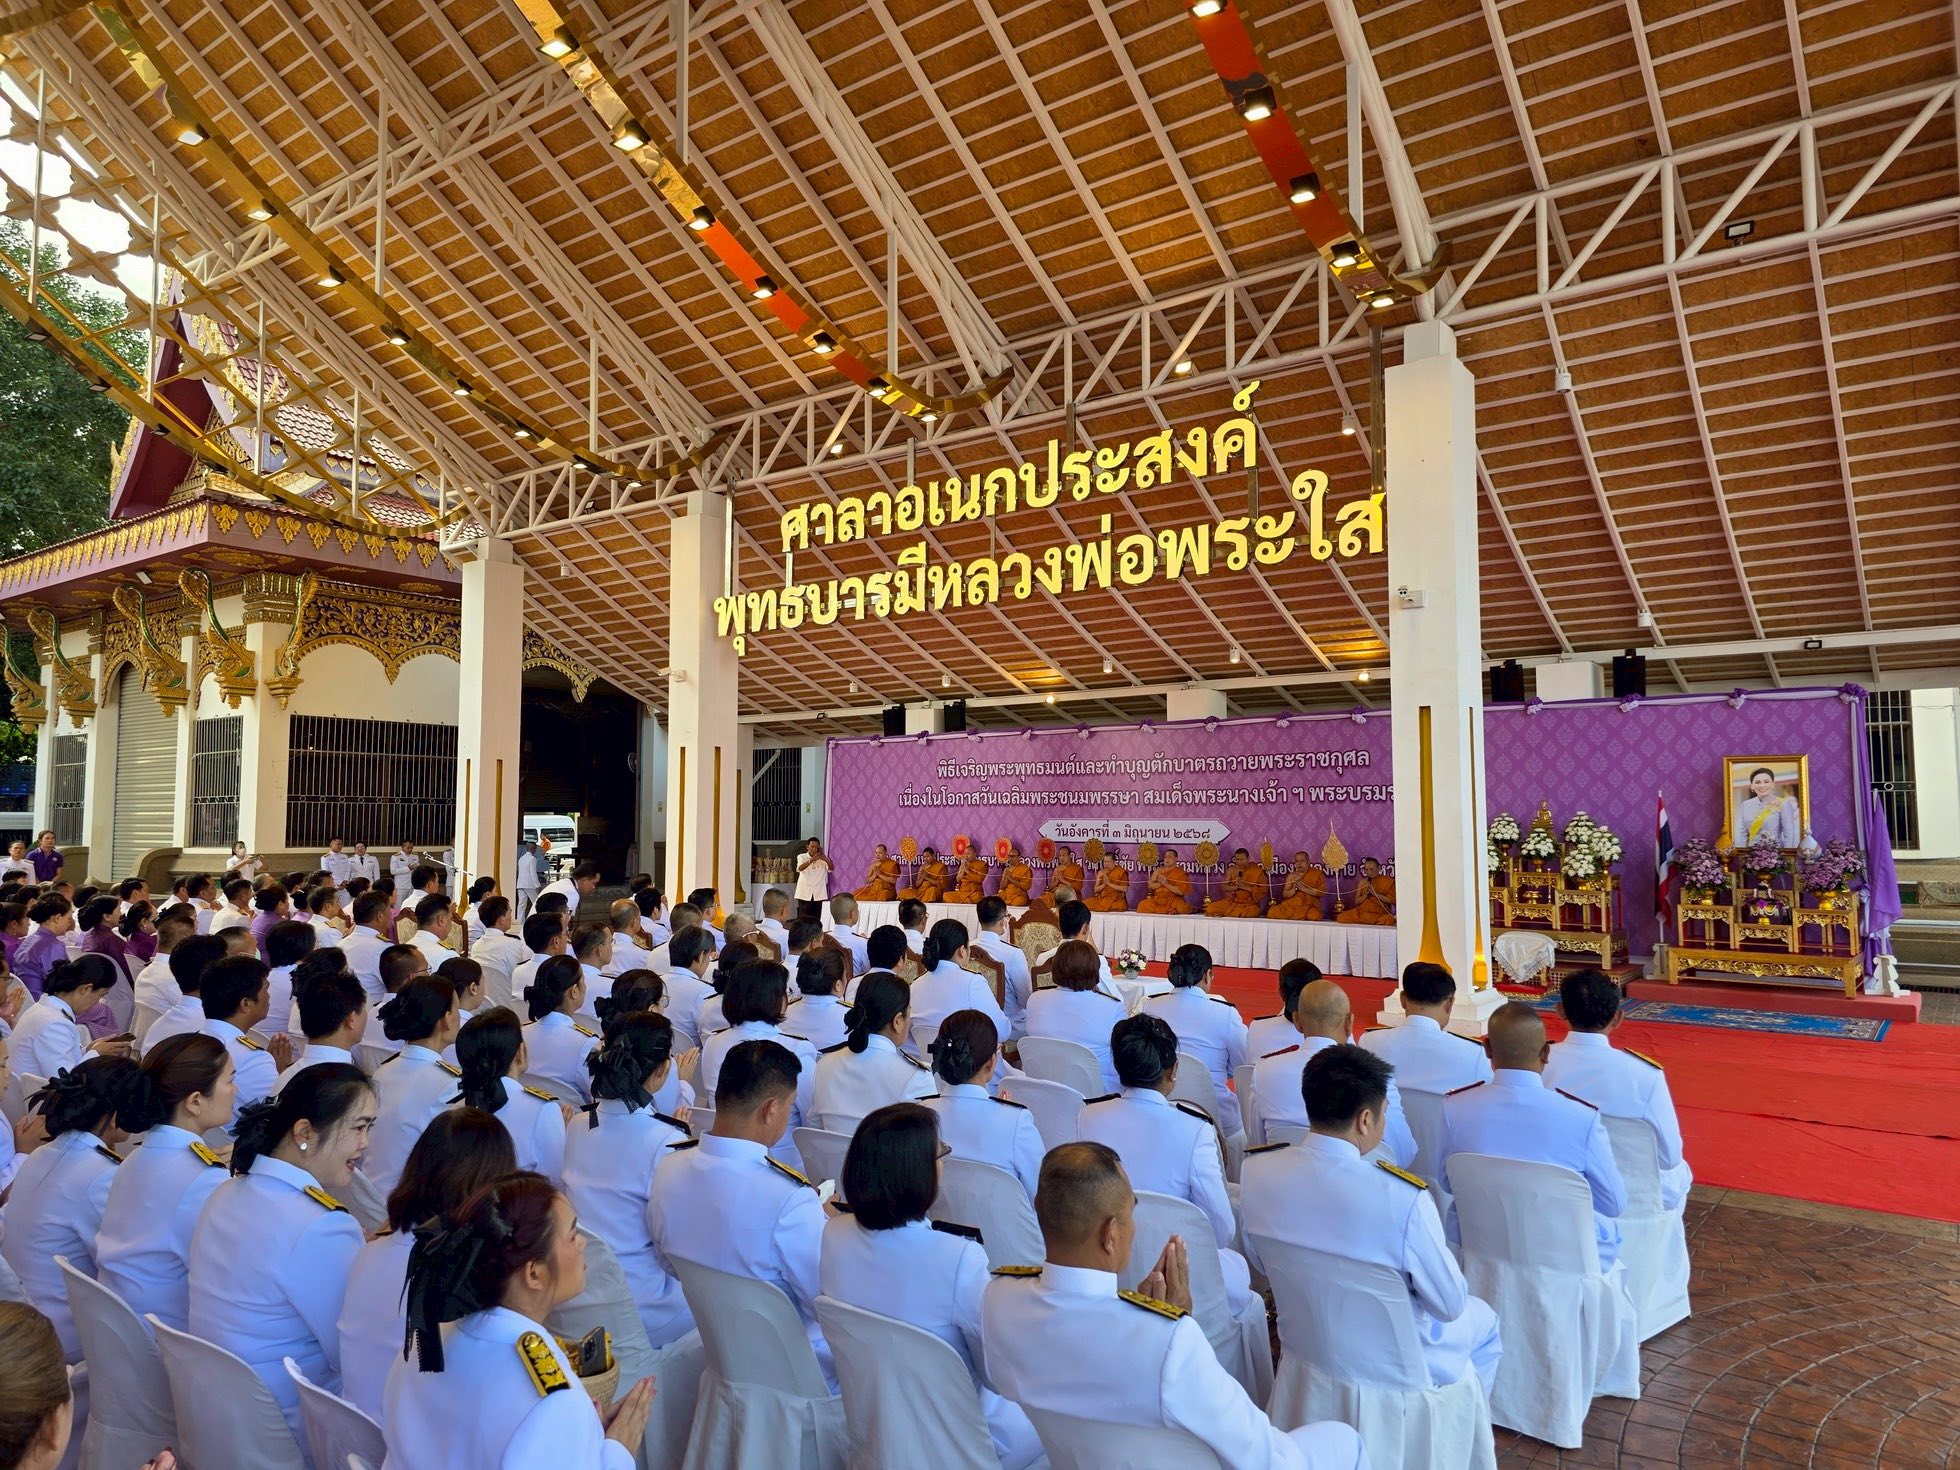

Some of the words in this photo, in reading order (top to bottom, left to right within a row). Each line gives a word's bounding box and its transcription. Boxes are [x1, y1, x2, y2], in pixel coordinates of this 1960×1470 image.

[780, 381, 1260, 553] ศาลาอเนกประสงค์
[713, 469, 1386, 657] พุทธบารมีหลวงพ่อพระใส
[1054, 820, 1110, 838] วันอังคารที่
[1123, 823, 1170, 843] มิถุนายน
[1173, 828, 1211, 840] ๒๕๖๘
[1143, 779, 1287, 805] สมเด็จพระนางเจ้า
